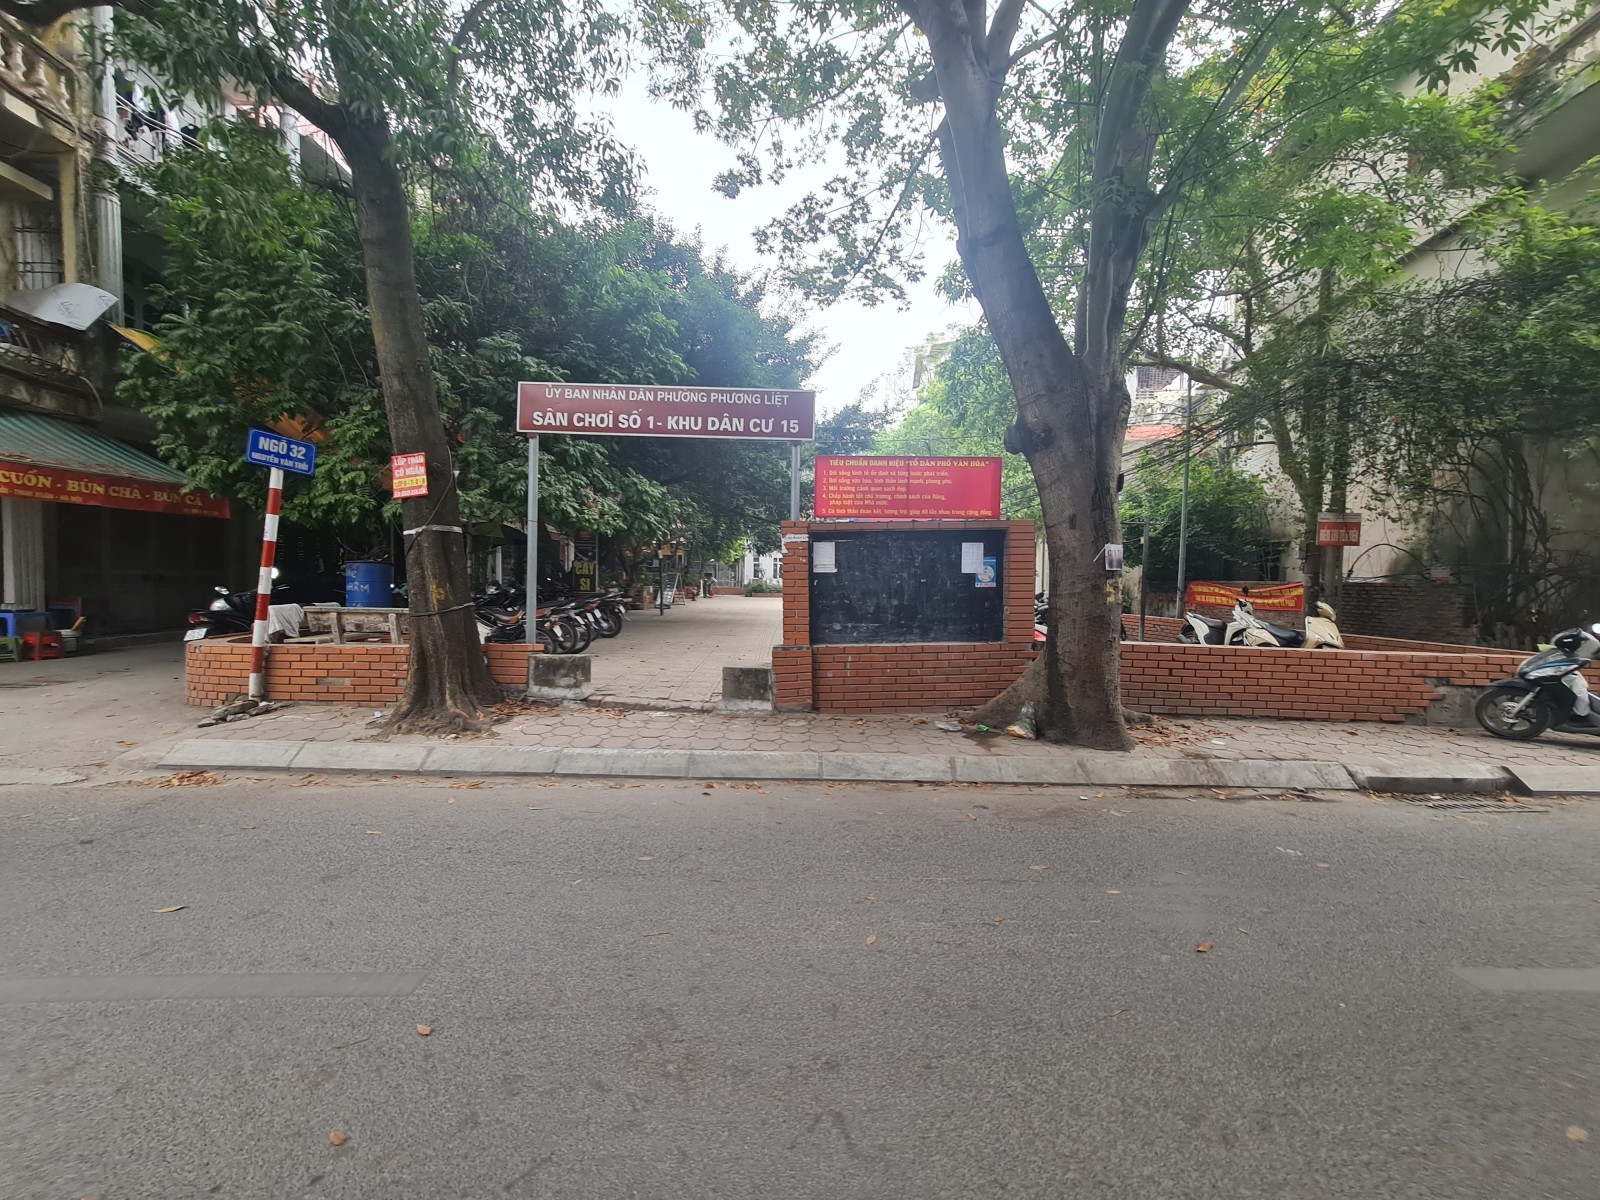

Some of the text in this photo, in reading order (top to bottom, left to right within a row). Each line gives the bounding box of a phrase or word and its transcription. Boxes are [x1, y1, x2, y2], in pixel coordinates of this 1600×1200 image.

[546, 385, 789, 408] ỦY BAN NHÂN DÂN PHƯỜNG PHƯƠNG LIỆT
[532, 408, 568, 426] SÂN
[572, 410, 614, 428] CHƠI
[618, 408, 642, 429] SỐ
[667, 416, 702, 431] KHU
[707, 413, 744, 432] DÂN
[749, 418, 774, 433] CƯ
[780, 420, 799, 433] 15
[258, 436, 306, 459] NGÕ 32
[67, 479, 105, 495] BÚN
[109, 484, 142, 499] CHÀ
